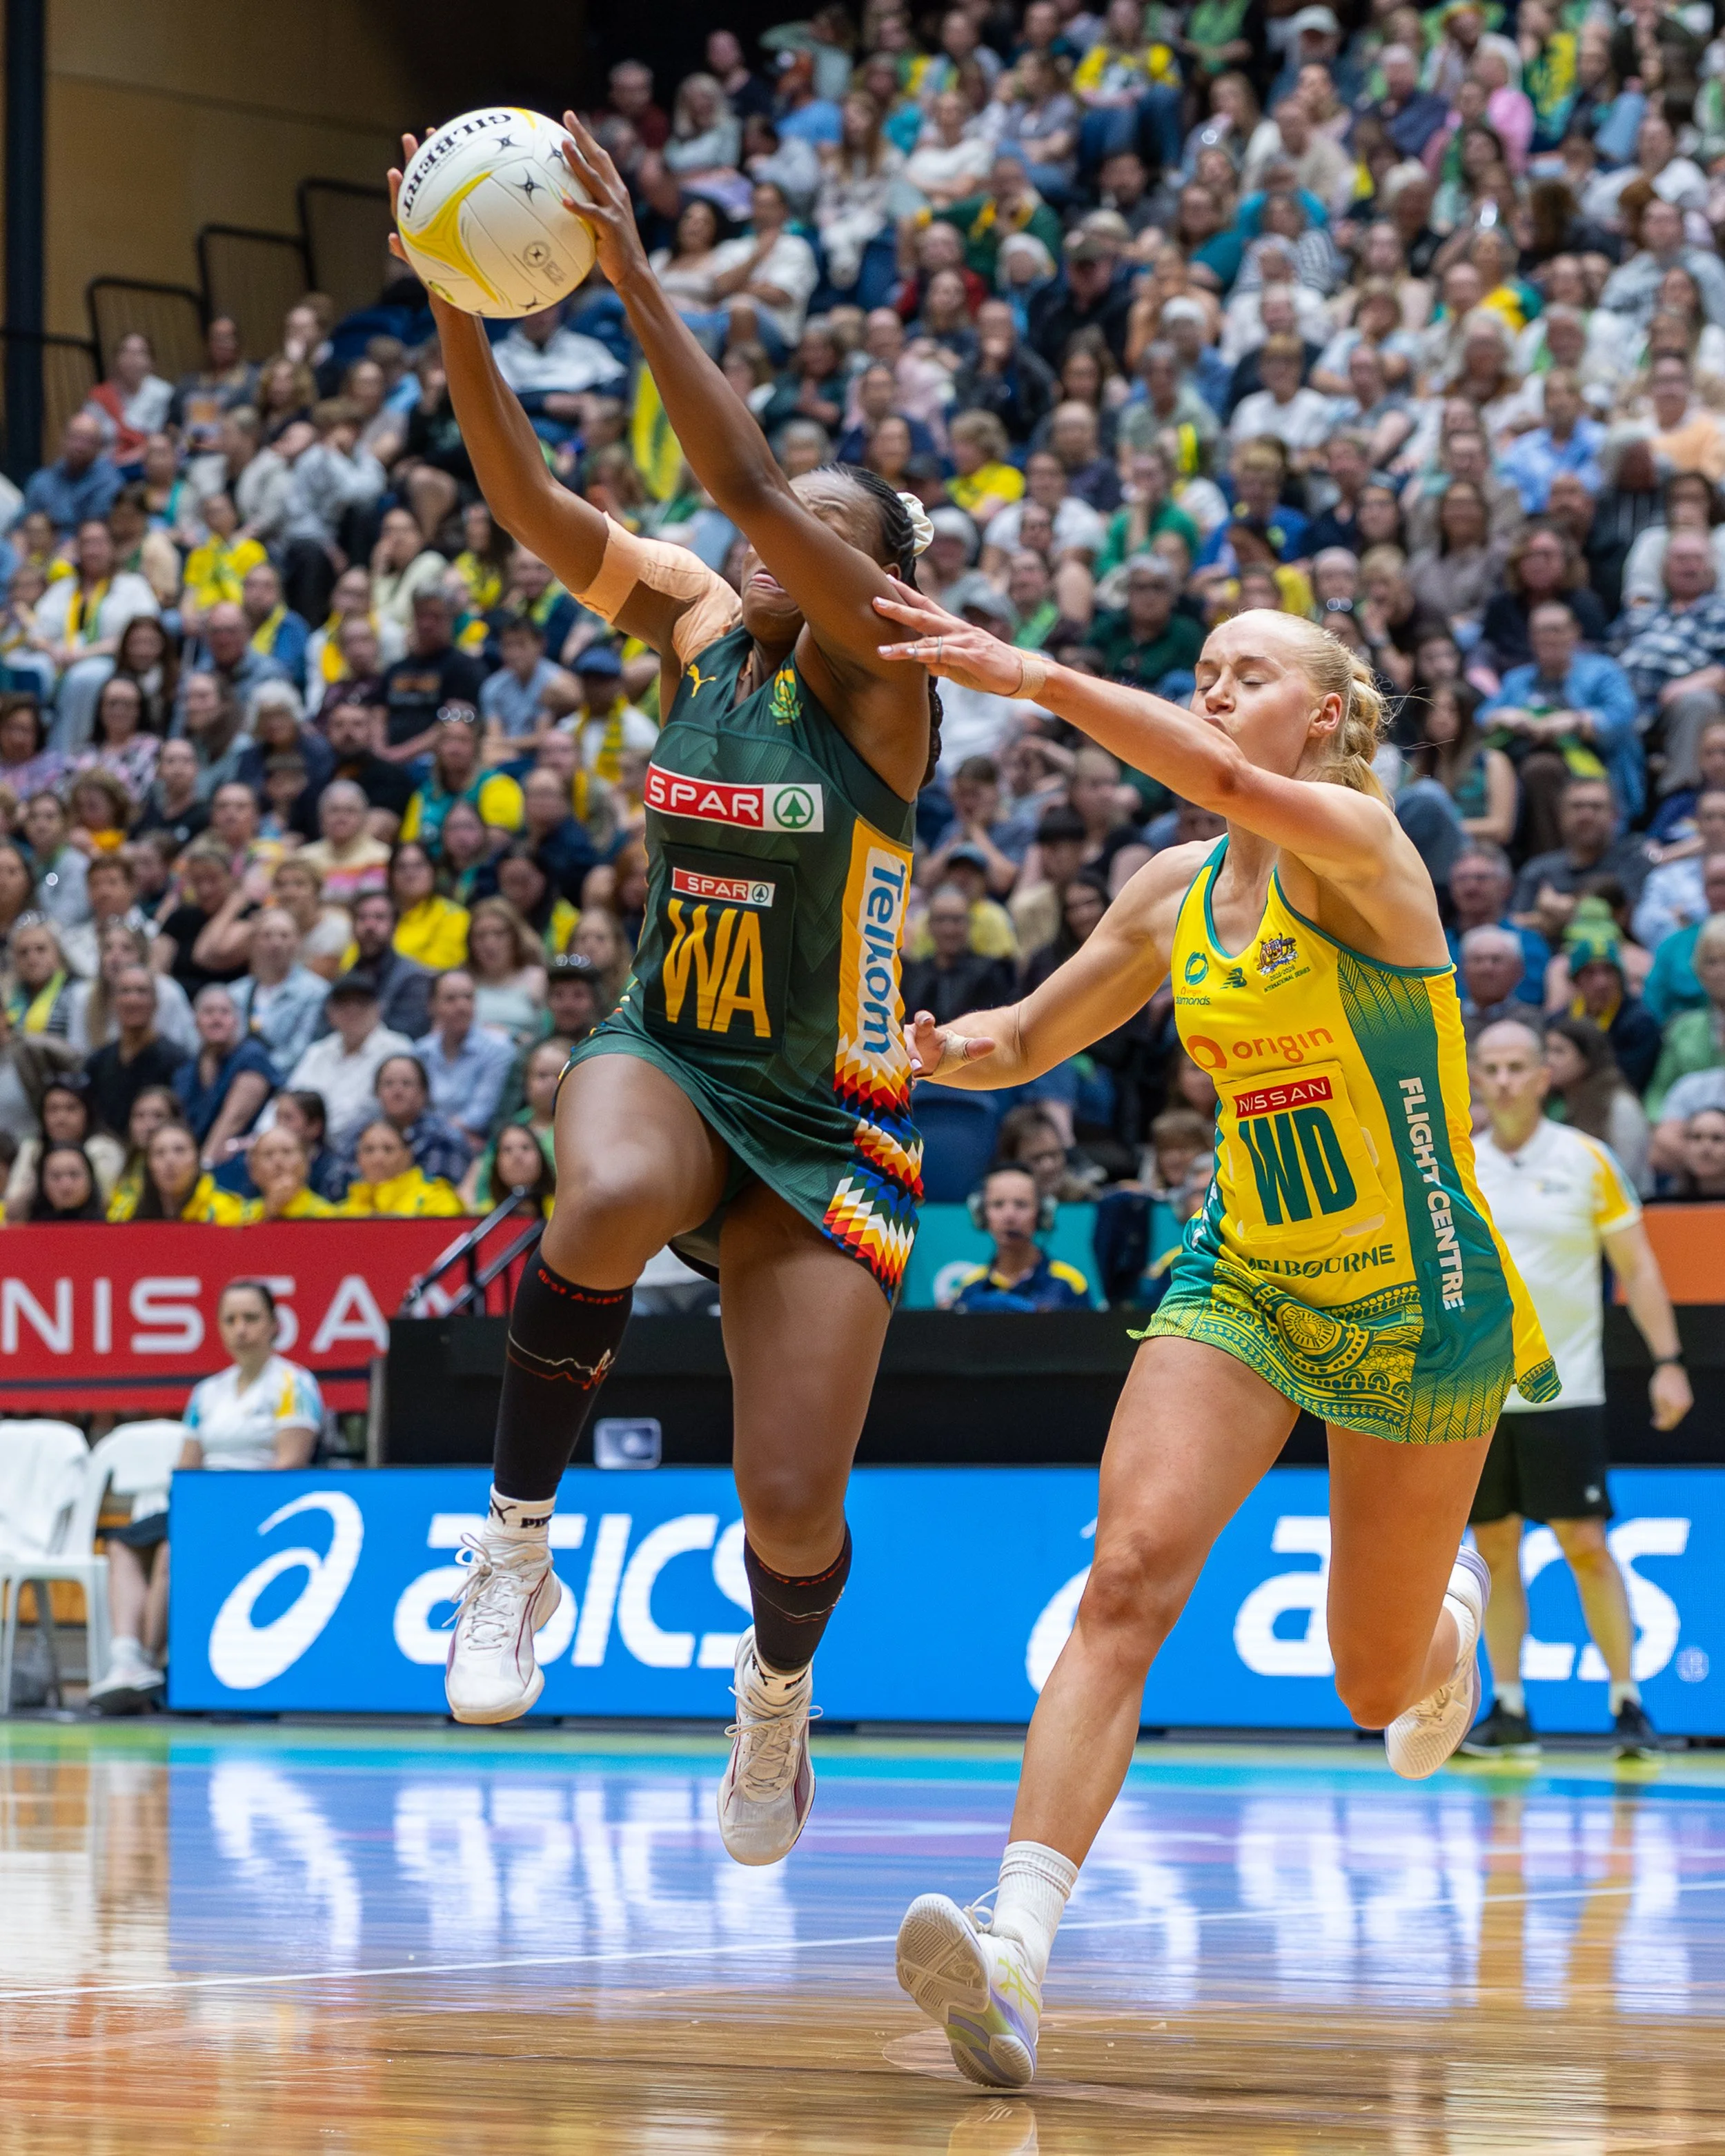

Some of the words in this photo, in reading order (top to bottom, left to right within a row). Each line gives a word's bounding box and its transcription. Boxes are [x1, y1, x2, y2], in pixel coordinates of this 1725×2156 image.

[403, 113, 511, 218] GILBERT
[649, 776, 760, 822] SPAR
[687, 876, 747, 899] SPAR
[662, 898, 771, 1038] WA
[862, 864, 907, 1054] Telkom
[1232, 1027, 1334, 1063] origin
[1239, 1081, 1327, 1114] NISSAN
[1238, 1106, 1359, 1226] WD
[1399, 1077, 1442, 1187] FLIGHT
[1427, 1190, 1464, 1310] CENTRE
